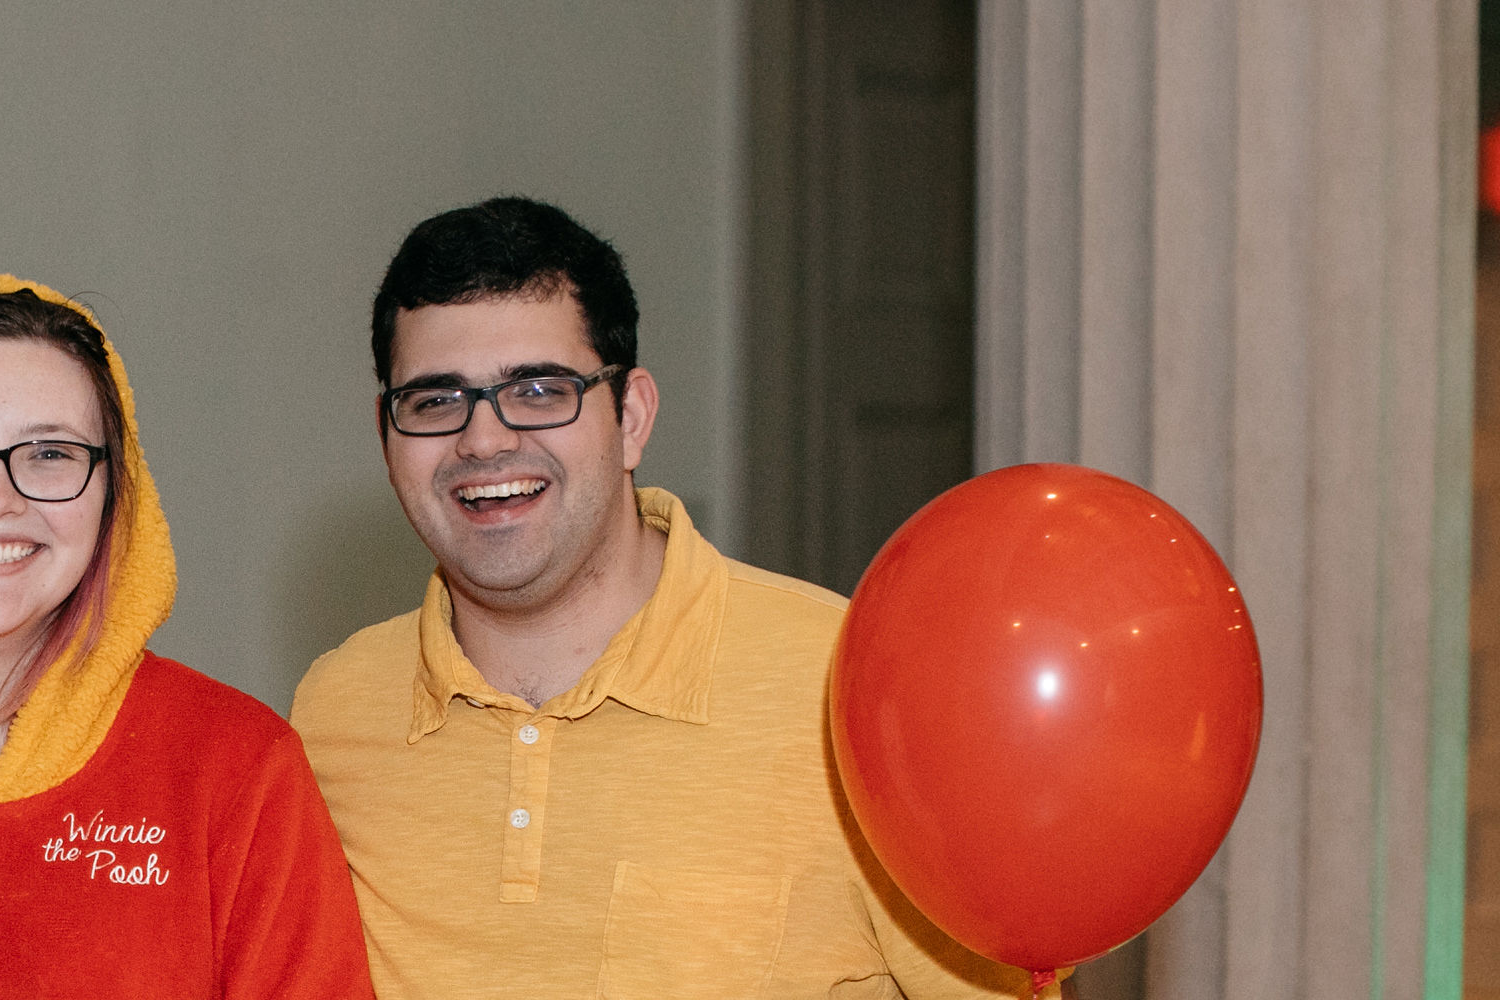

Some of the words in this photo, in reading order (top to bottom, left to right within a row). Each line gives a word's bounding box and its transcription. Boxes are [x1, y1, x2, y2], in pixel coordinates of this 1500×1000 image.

[62, 809, 167, 844] Winnie
[41, 837, 82, 862] the
[85, 849, 170, 886] Pooh
